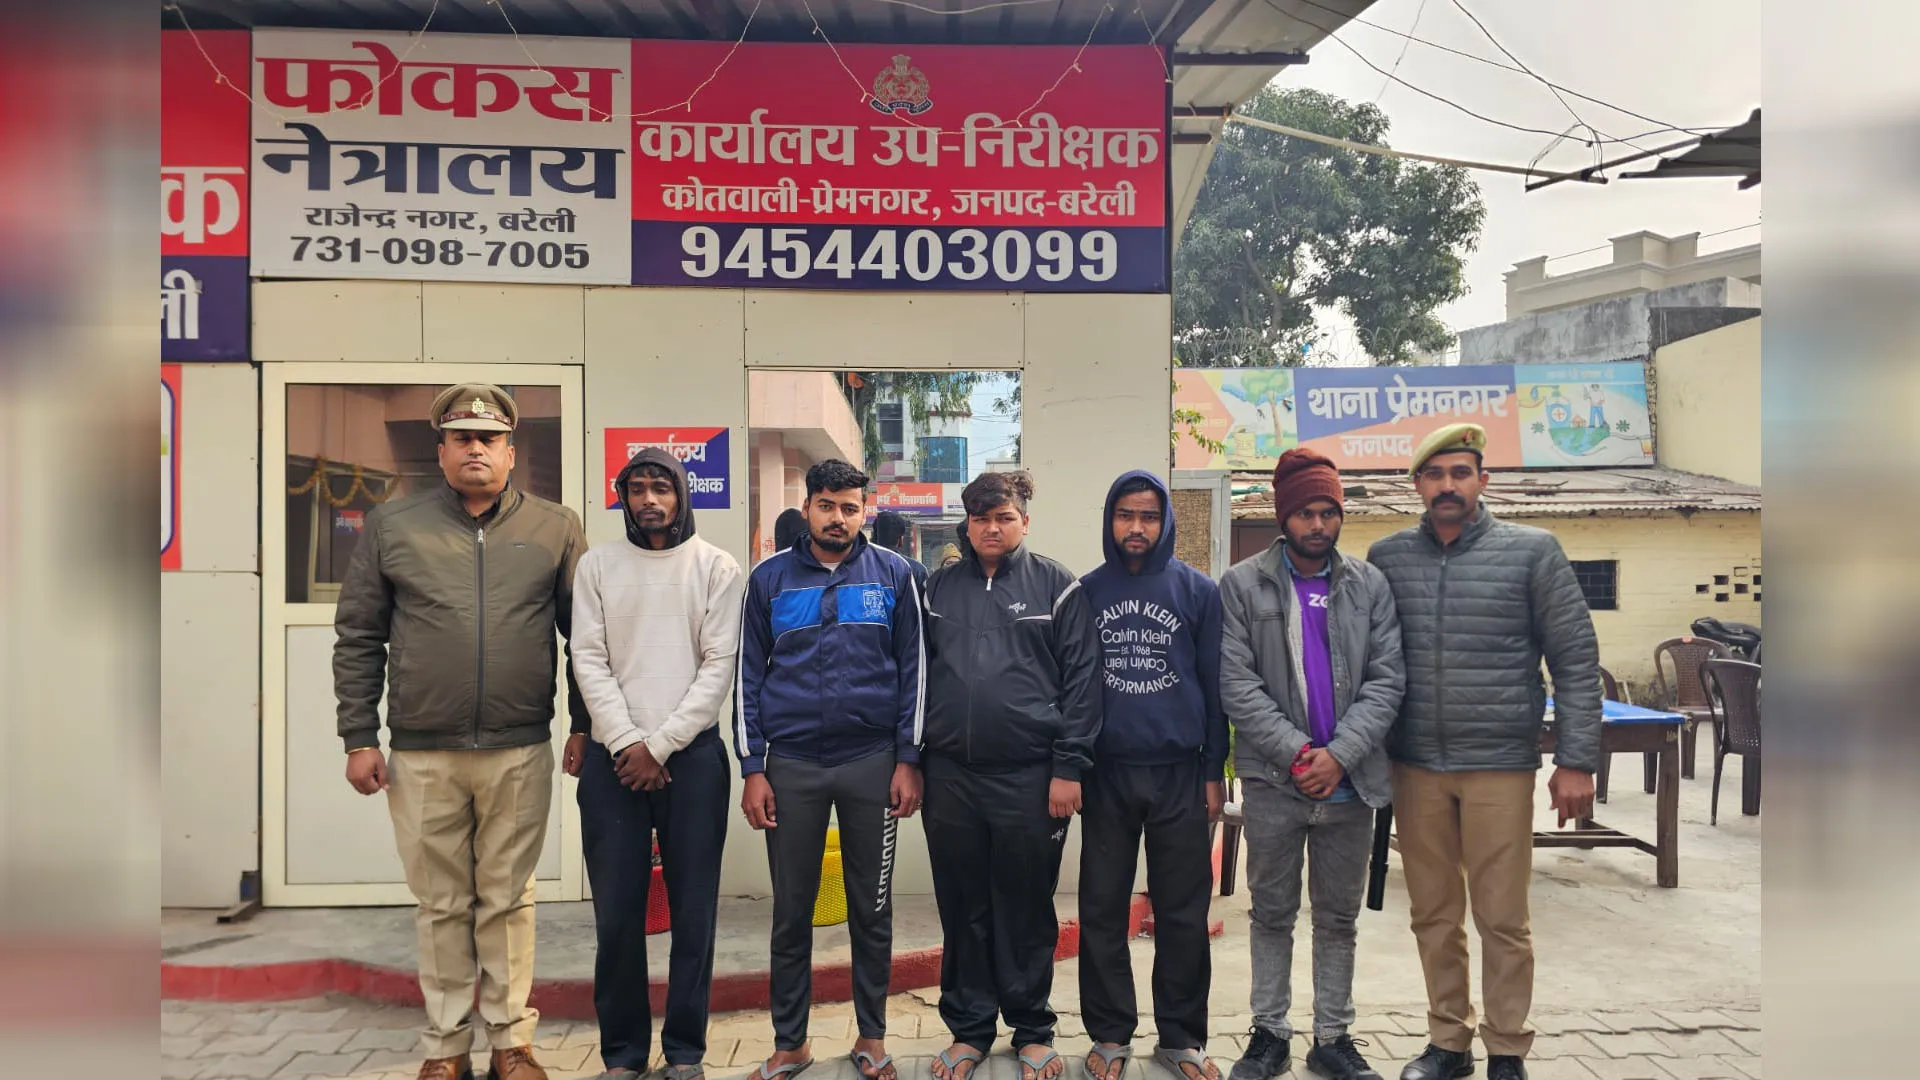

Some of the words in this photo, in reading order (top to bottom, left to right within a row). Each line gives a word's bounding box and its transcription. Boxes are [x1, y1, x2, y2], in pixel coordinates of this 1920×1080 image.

[255, 41, 623, 122] फोकस
[636, 108, 858, 165] कार्यालय
[870, 112, 1159, 170] उप-निरीक्षक
[255, 122, 626, 199] नेत्रालय
[661, 176, 941, 220] कोतवाली-प्रेमनगर,
[951, 180, 1137, 217] जनपद-बरेली
[304, 203, 396, 230] राजेन्द्र
[406, 209, 488, 235] नगर,
[497, 208, 577, 233] बरेली
[290, 235, 591, 269] 731-098-7005
[681, 226, 1118, 282] 9454403099
[1307, 387, 1379, 420] थाना
[1384, 374, 1510, 425] प्रेमनगर
[1340, 434, 1415, 457] जनपद
[1095, 599, 1139, 629] CALVIN
[1142, 601, 1181, 633] KLEIN
[1101, 628, 1138, 644] Calvin
[1141, 628, 1172, 646] Klein
[1132, 645, 1151, 656] 1968
[1130, 656, 1167, 672] Calvin
